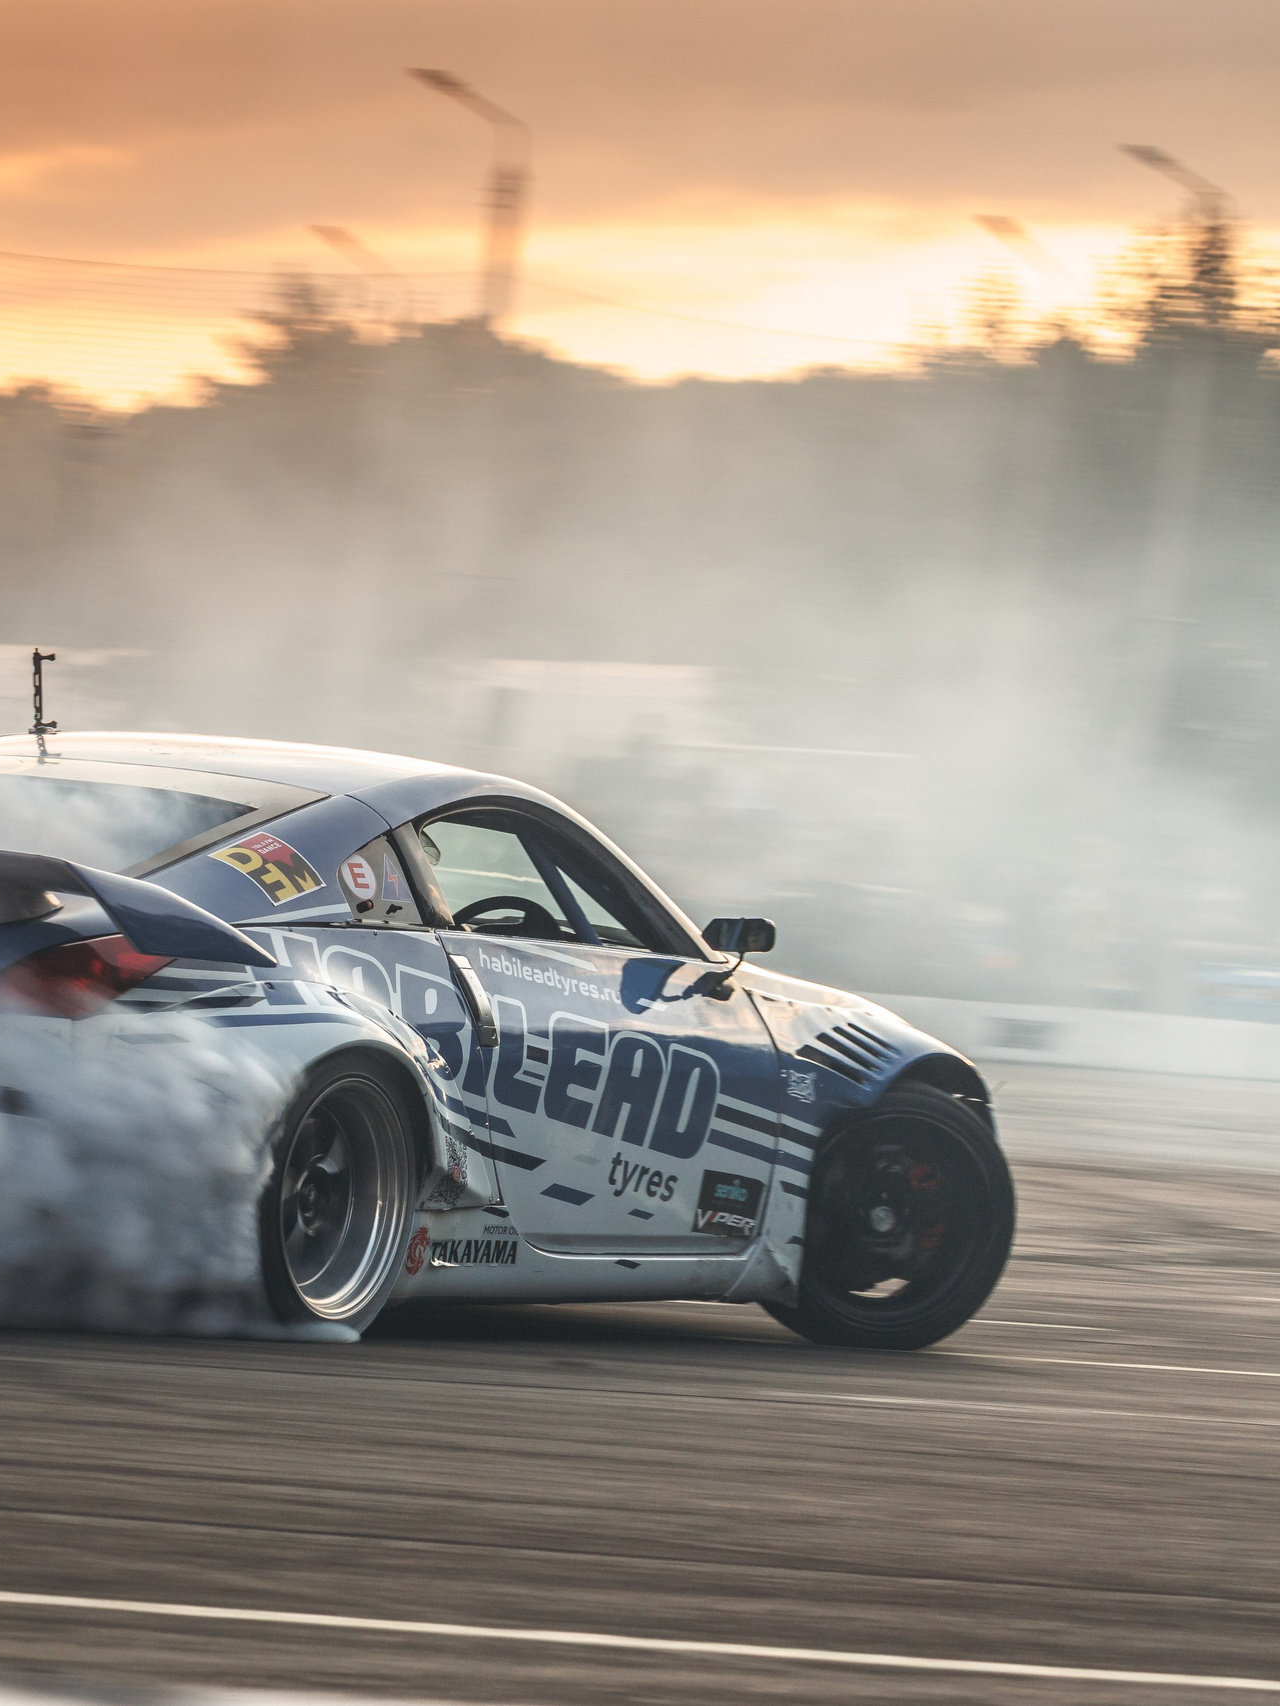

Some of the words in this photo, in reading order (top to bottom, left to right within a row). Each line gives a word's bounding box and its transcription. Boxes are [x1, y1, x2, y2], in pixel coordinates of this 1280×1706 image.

[257, 841, 283, 855] DANCE
[346, 862, 370, 889] E
[478, 946, 622, 1005] habileadtyres.ru
[608, 1151, 680, 1202] tyres
[483, 1225, 508, 1235] MOTOR
[696, 1208, 756, 1236] VIPER
[430, 1239, 518, 1265] TAKAYAMA
